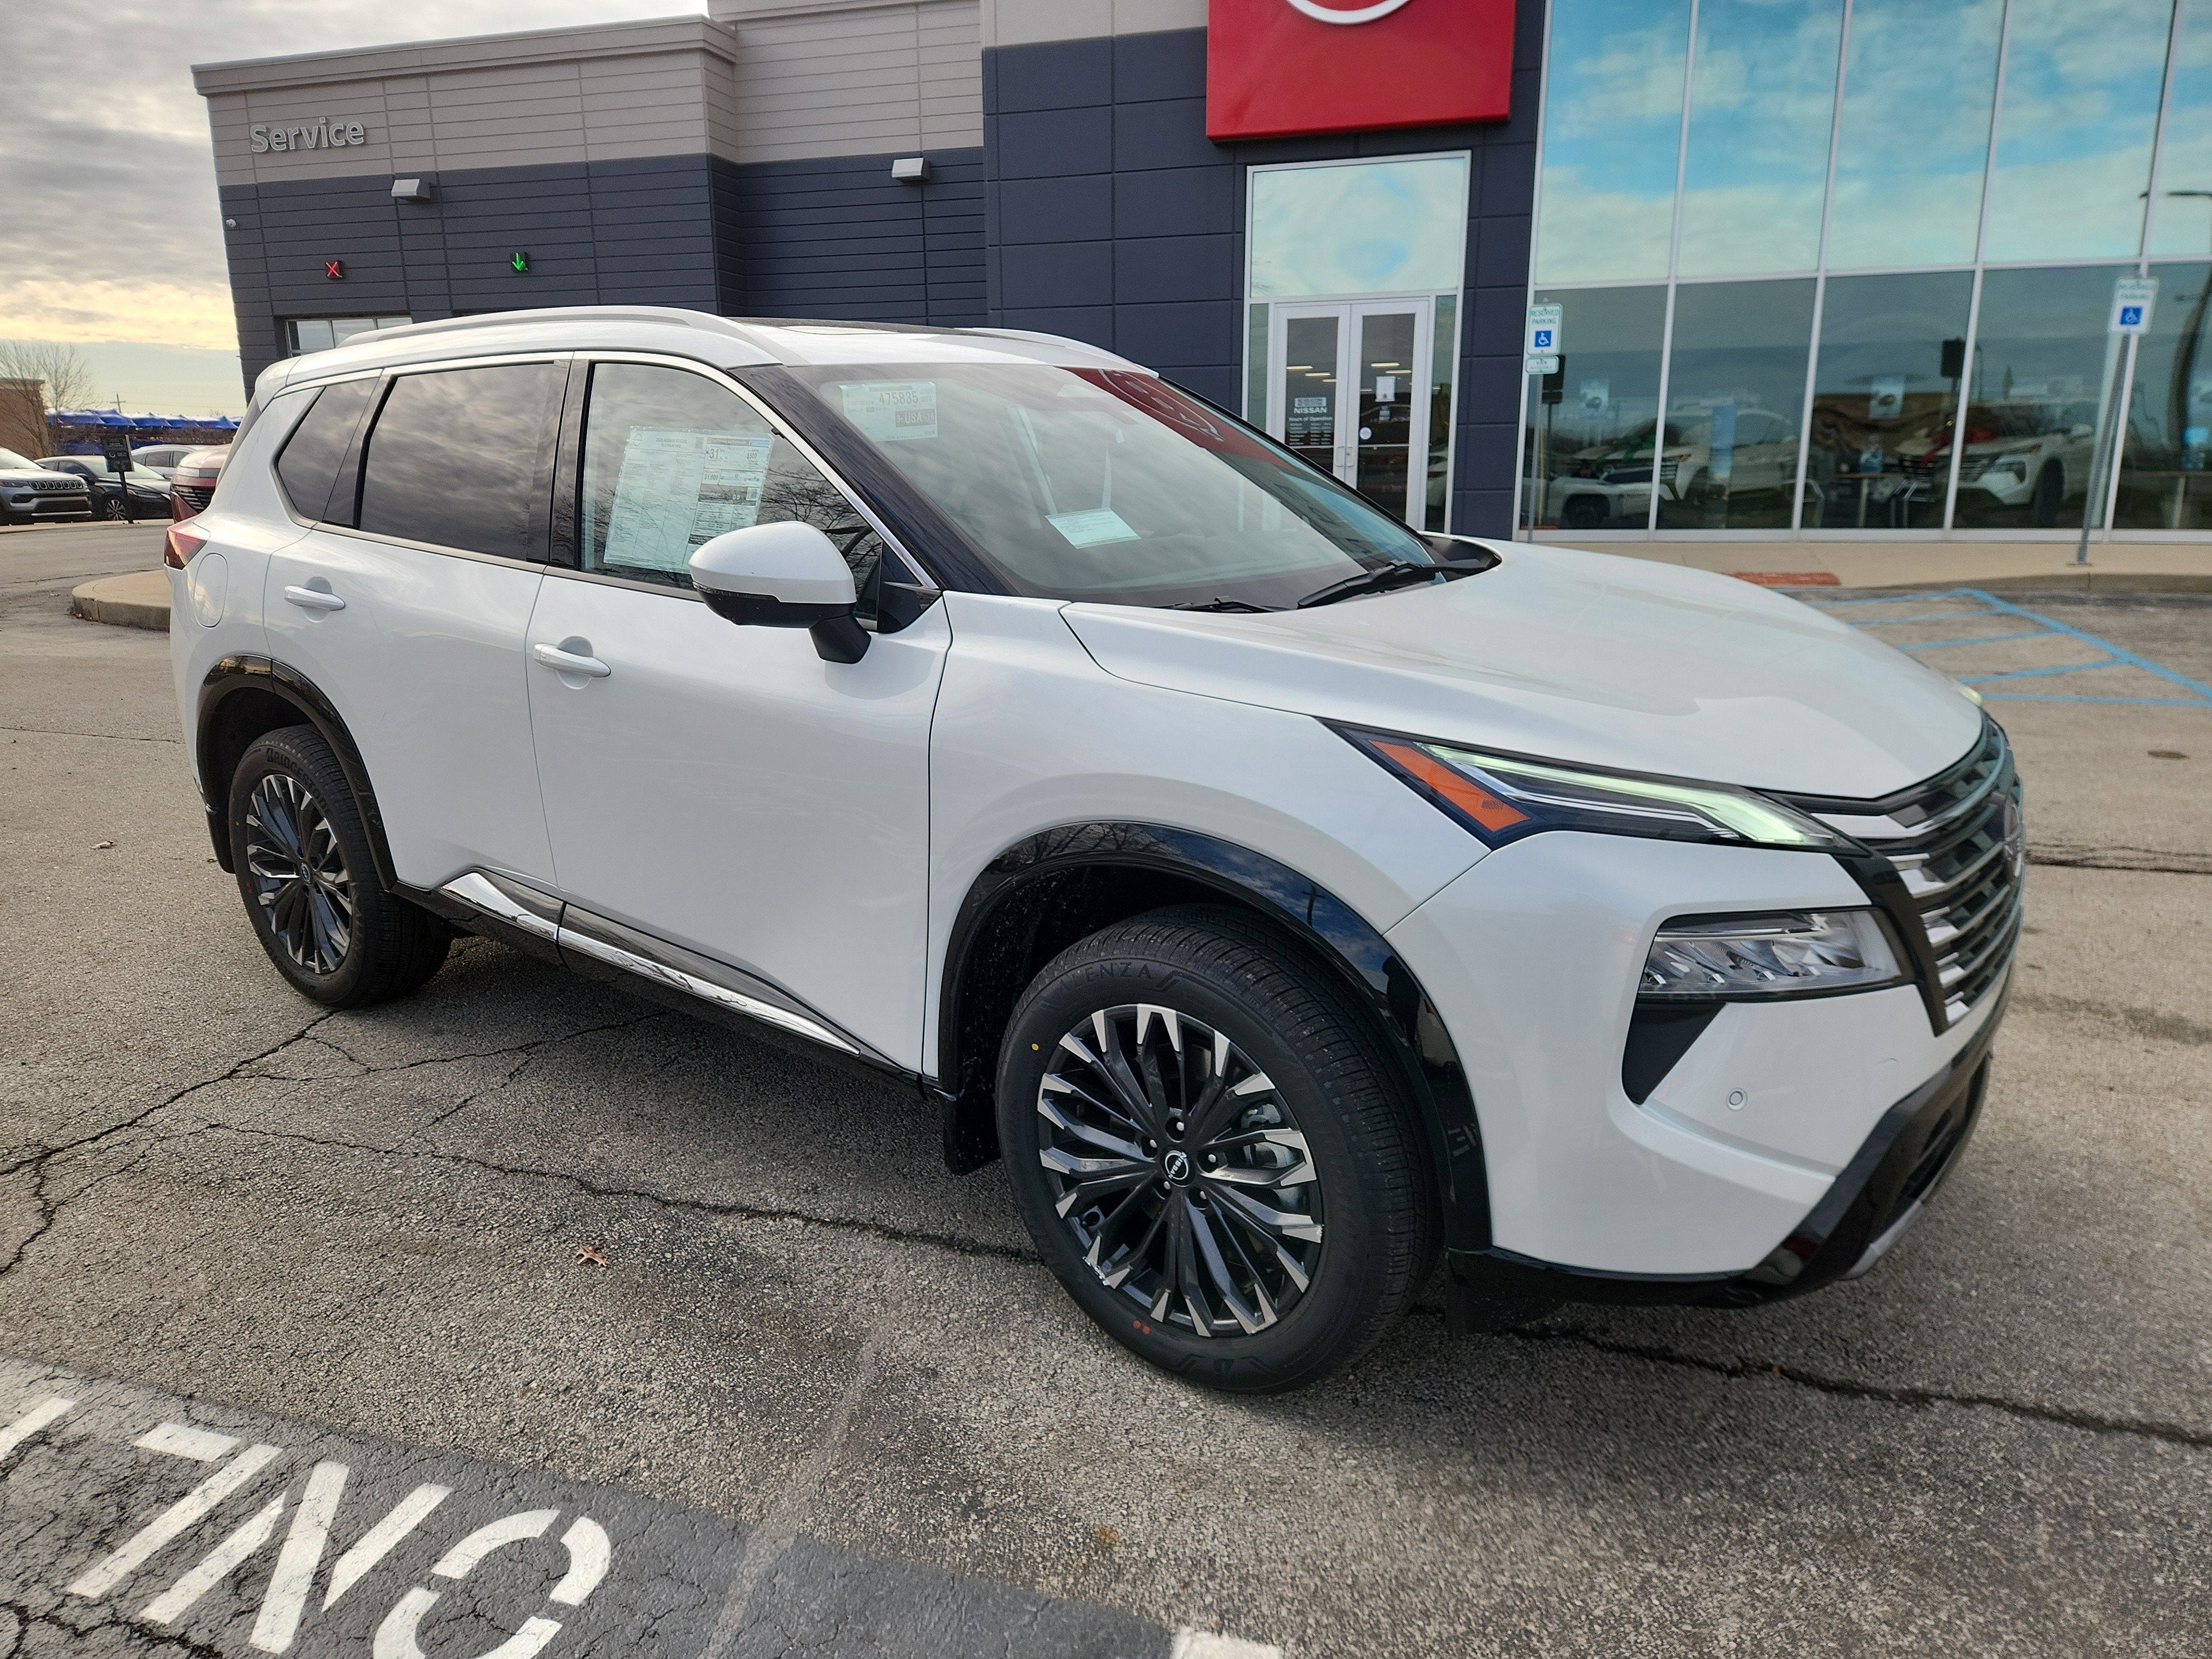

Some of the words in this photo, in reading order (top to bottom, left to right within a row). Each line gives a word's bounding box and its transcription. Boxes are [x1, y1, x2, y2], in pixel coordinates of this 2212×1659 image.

[250, 117, 364, 152] Service
[879, 391, 918, 406] 475835
[709, 448, 719, 459] 31
[1168, 1152, 1187, 1179] NISSAN
[0, 1397, 611, 1659] ONL
